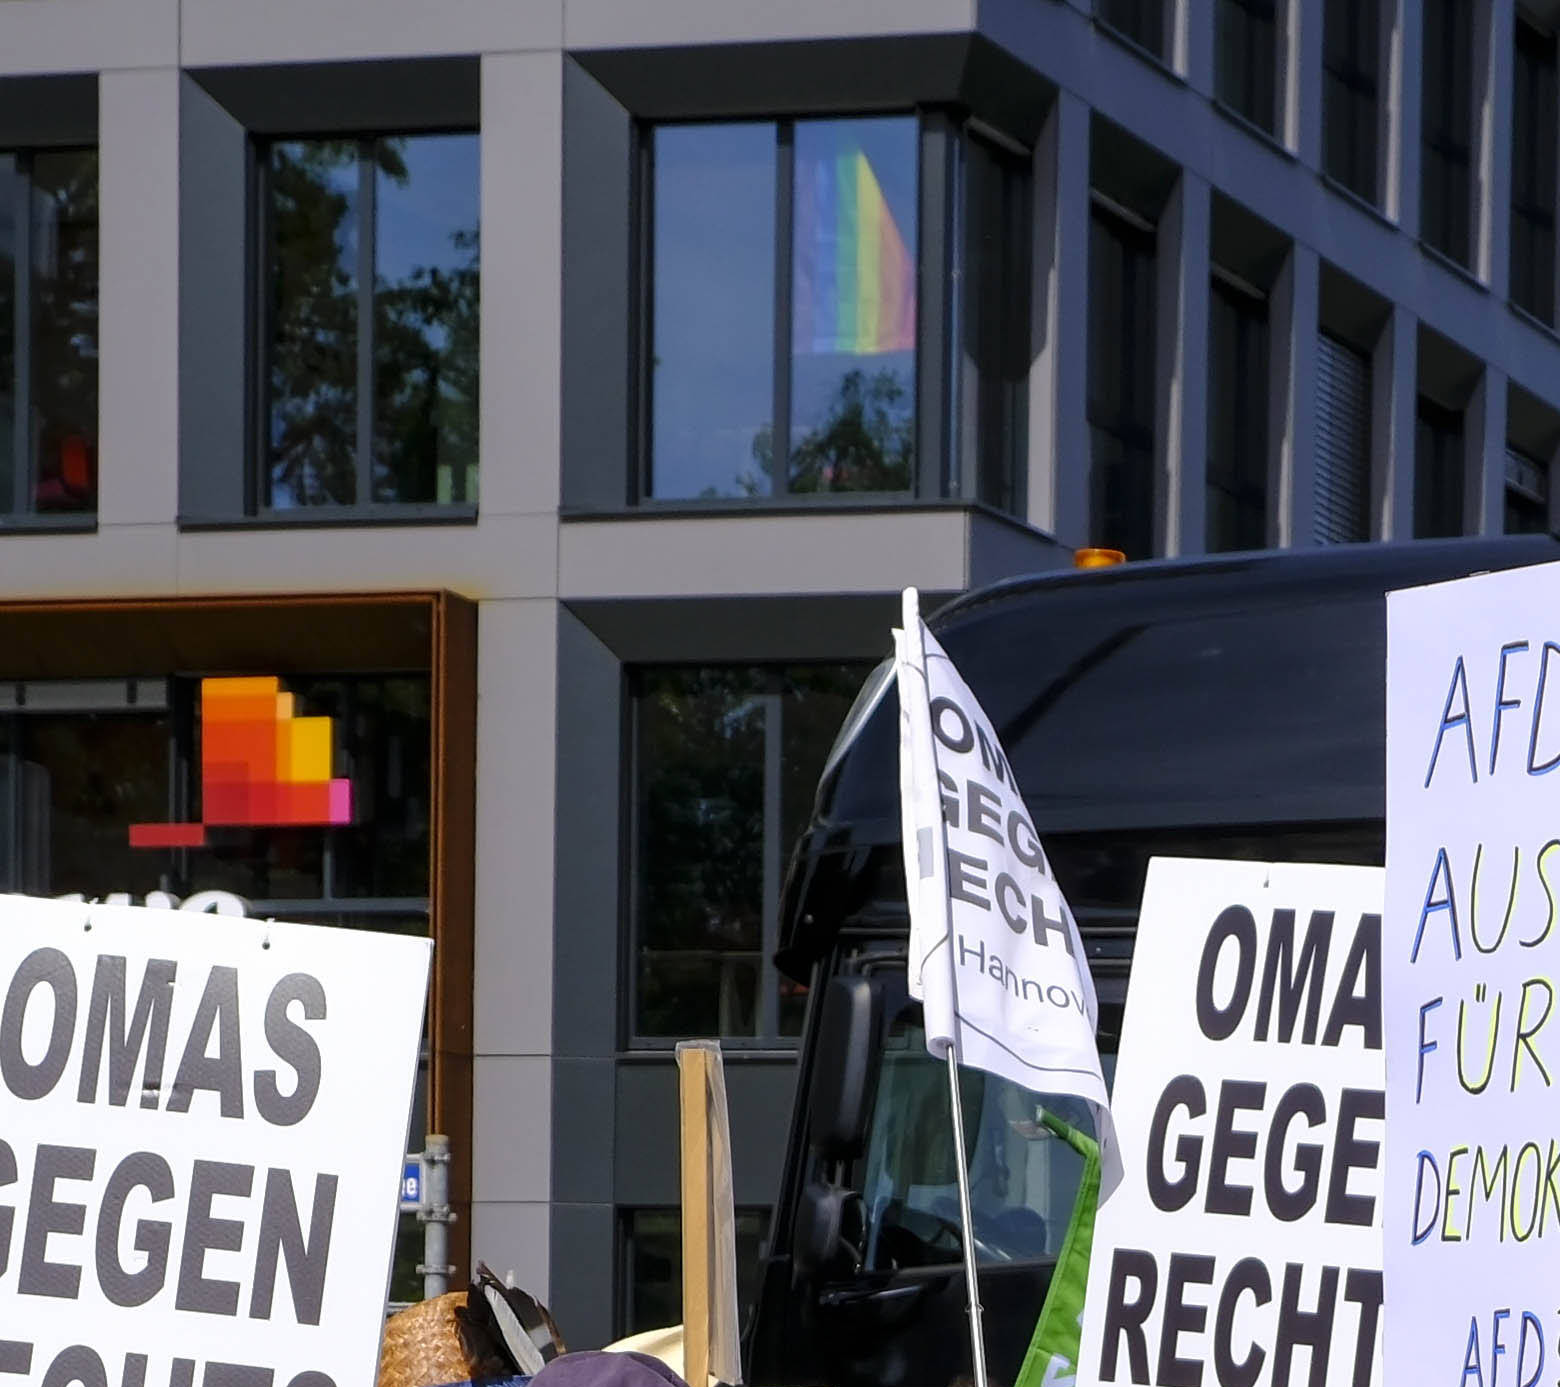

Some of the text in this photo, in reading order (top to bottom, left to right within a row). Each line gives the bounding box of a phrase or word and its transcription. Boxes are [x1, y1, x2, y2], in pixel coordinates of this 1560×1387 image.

[929, 696, 1019, 797] OM
[948, 848, 1076, 958] ECH
[0, 946, 327, 1127] OMAS
[958, 934, 1091, 1017] Hannov
[1195, 903, 1384, 1050] OMA
[1415, 977, 1553, 1106] FÜR
[1144, 1073, 1386, 1228] GEGE
